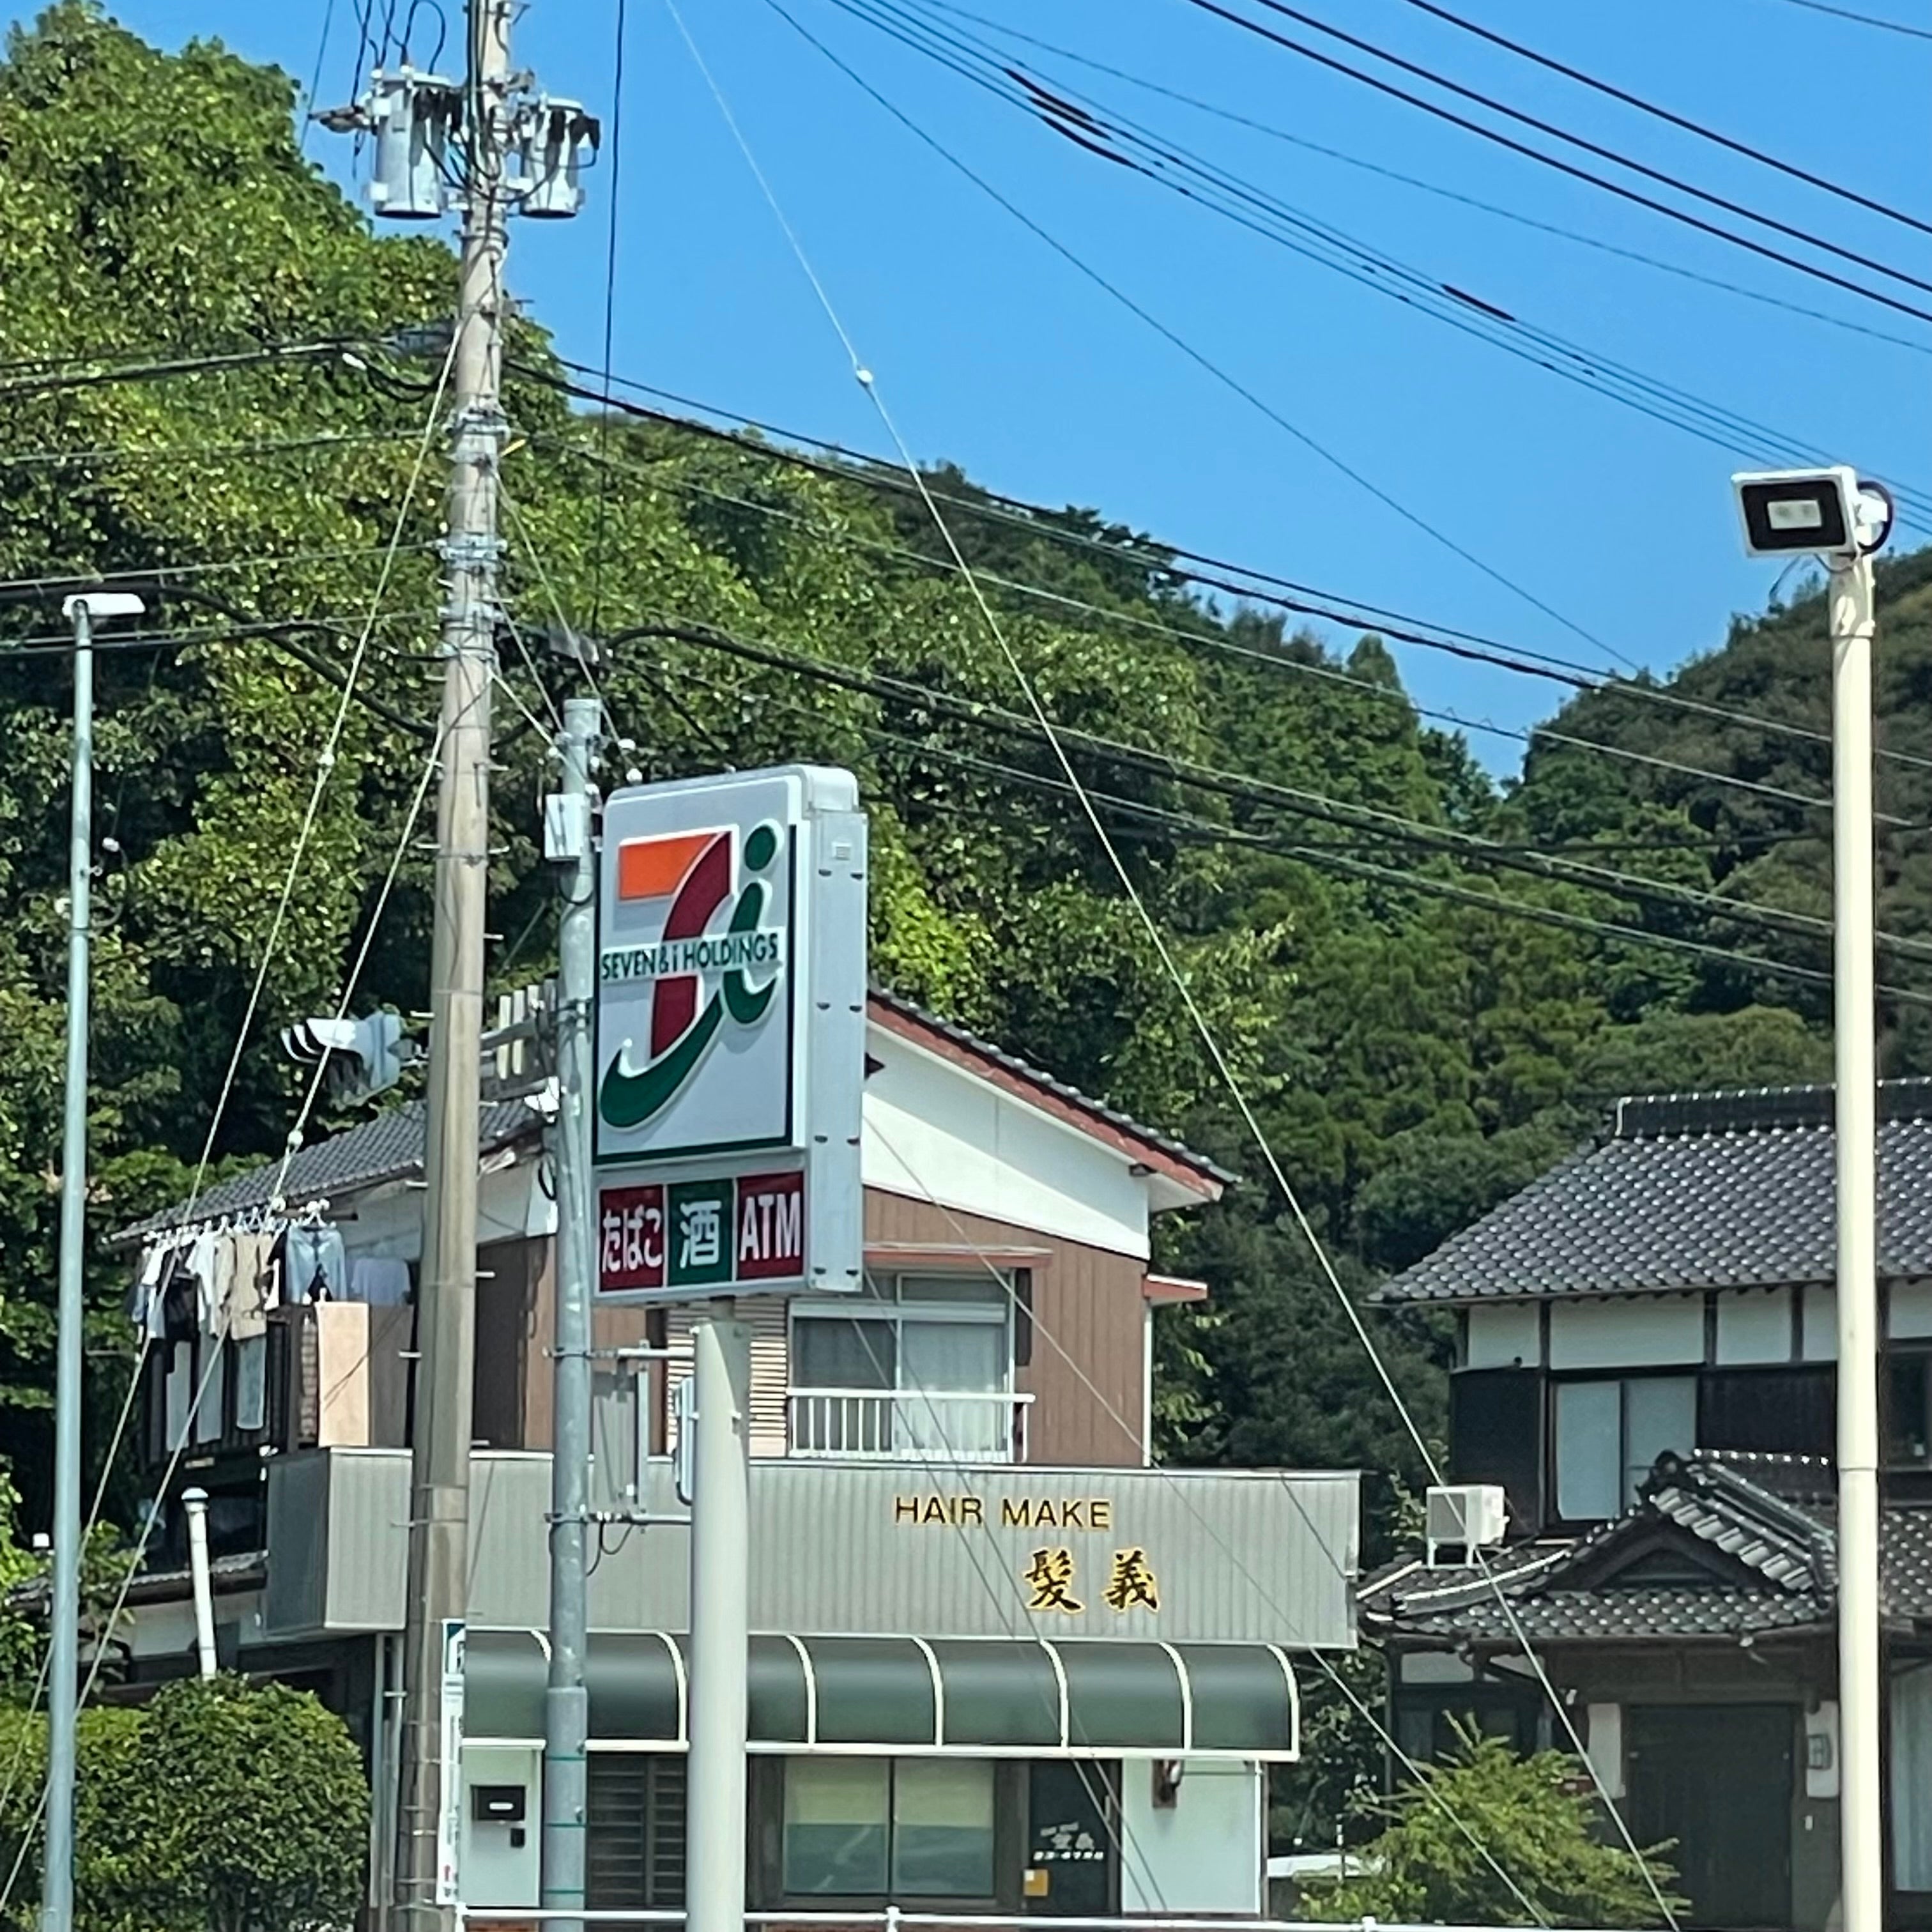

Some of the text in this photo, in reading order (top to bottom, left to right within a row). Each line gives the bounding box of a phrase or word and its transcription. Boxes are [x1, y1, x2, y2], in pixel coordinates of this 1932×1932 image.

[683, 933, 778, 971] HOLDINGS
[601, 1204, 663, 1273] たばこ
[679, 1199, 722, 1269] 酒
[739, 1191, 801, 1261] ATM
[894, 1496, 1111, 1529] HAIR MAKE
